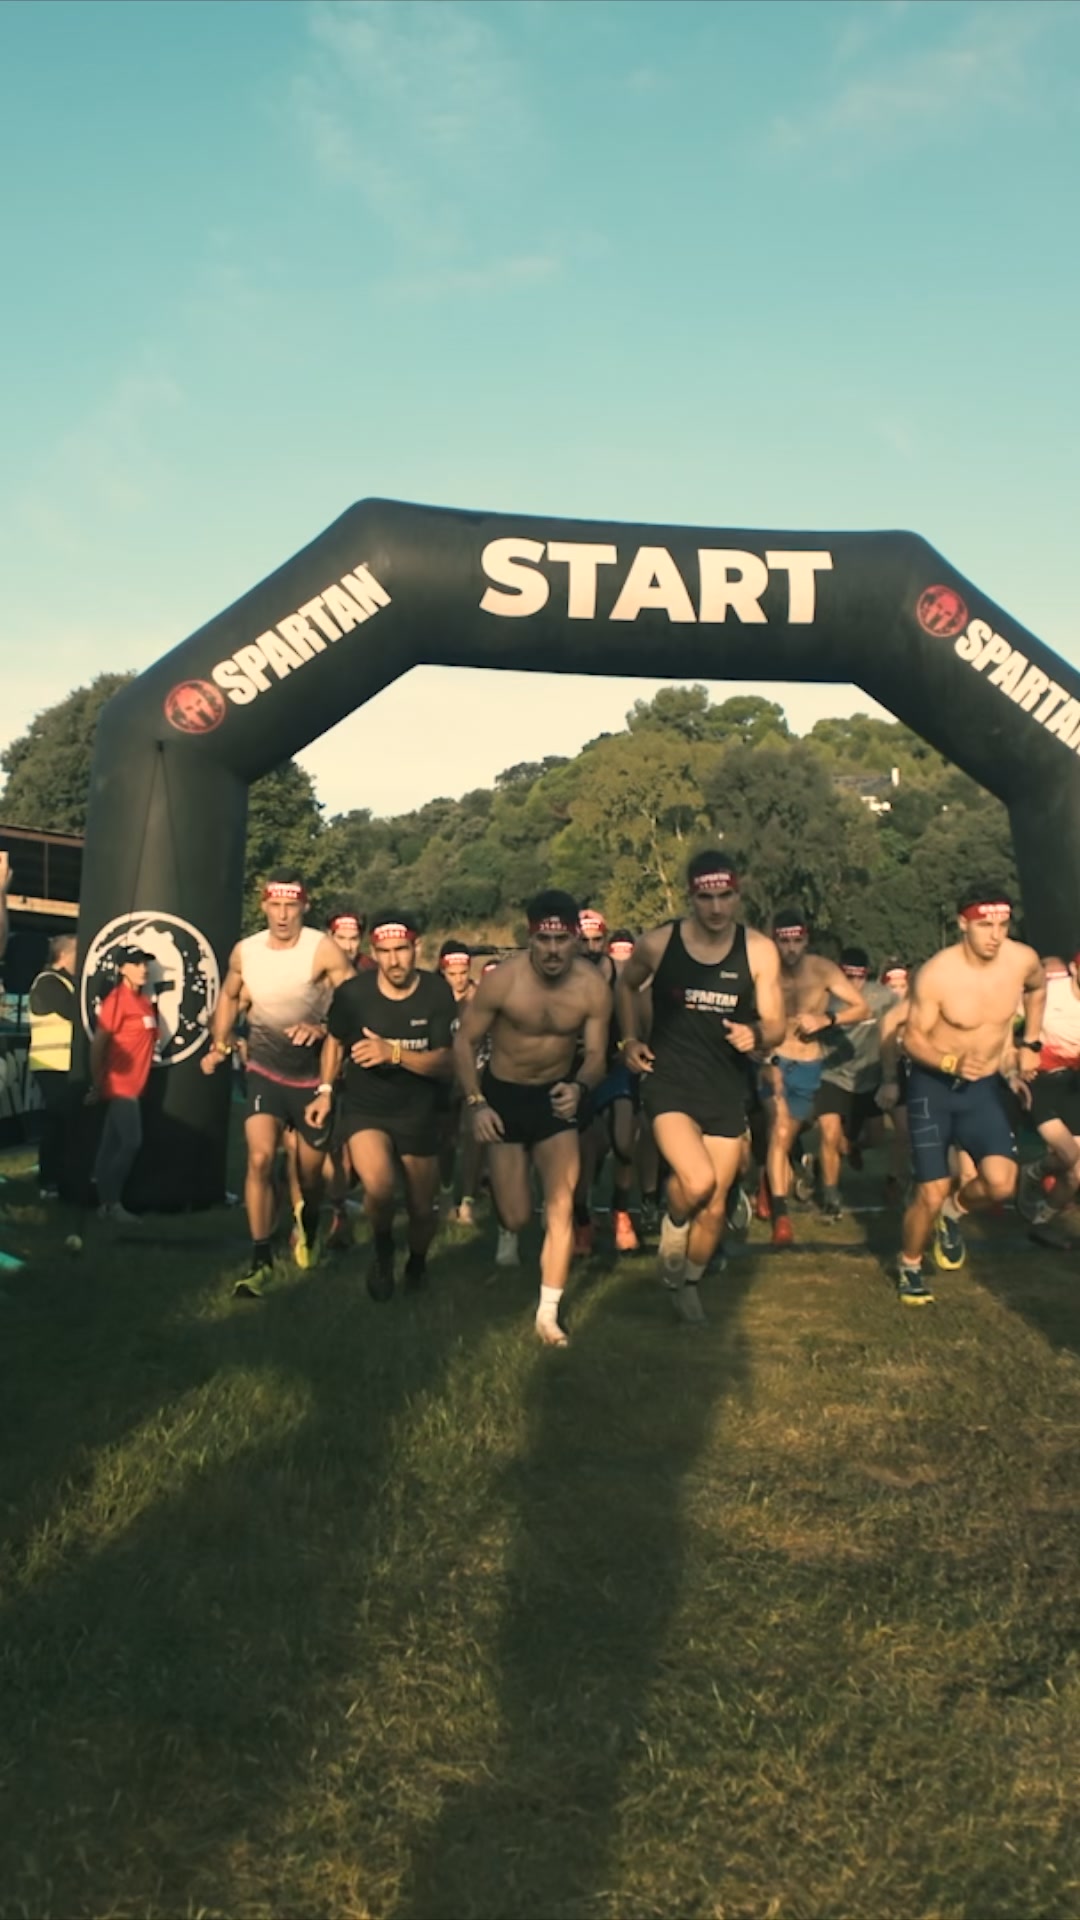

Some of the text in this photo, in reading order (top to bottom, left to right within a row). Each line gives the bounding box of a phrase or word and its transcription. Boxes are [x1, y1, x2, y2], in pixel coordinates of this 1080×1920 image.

[211, 564, 392, 705] SPARTAN
[479, 537, 833, 624] START
[954, 618, 1080, 757] SPARTA
